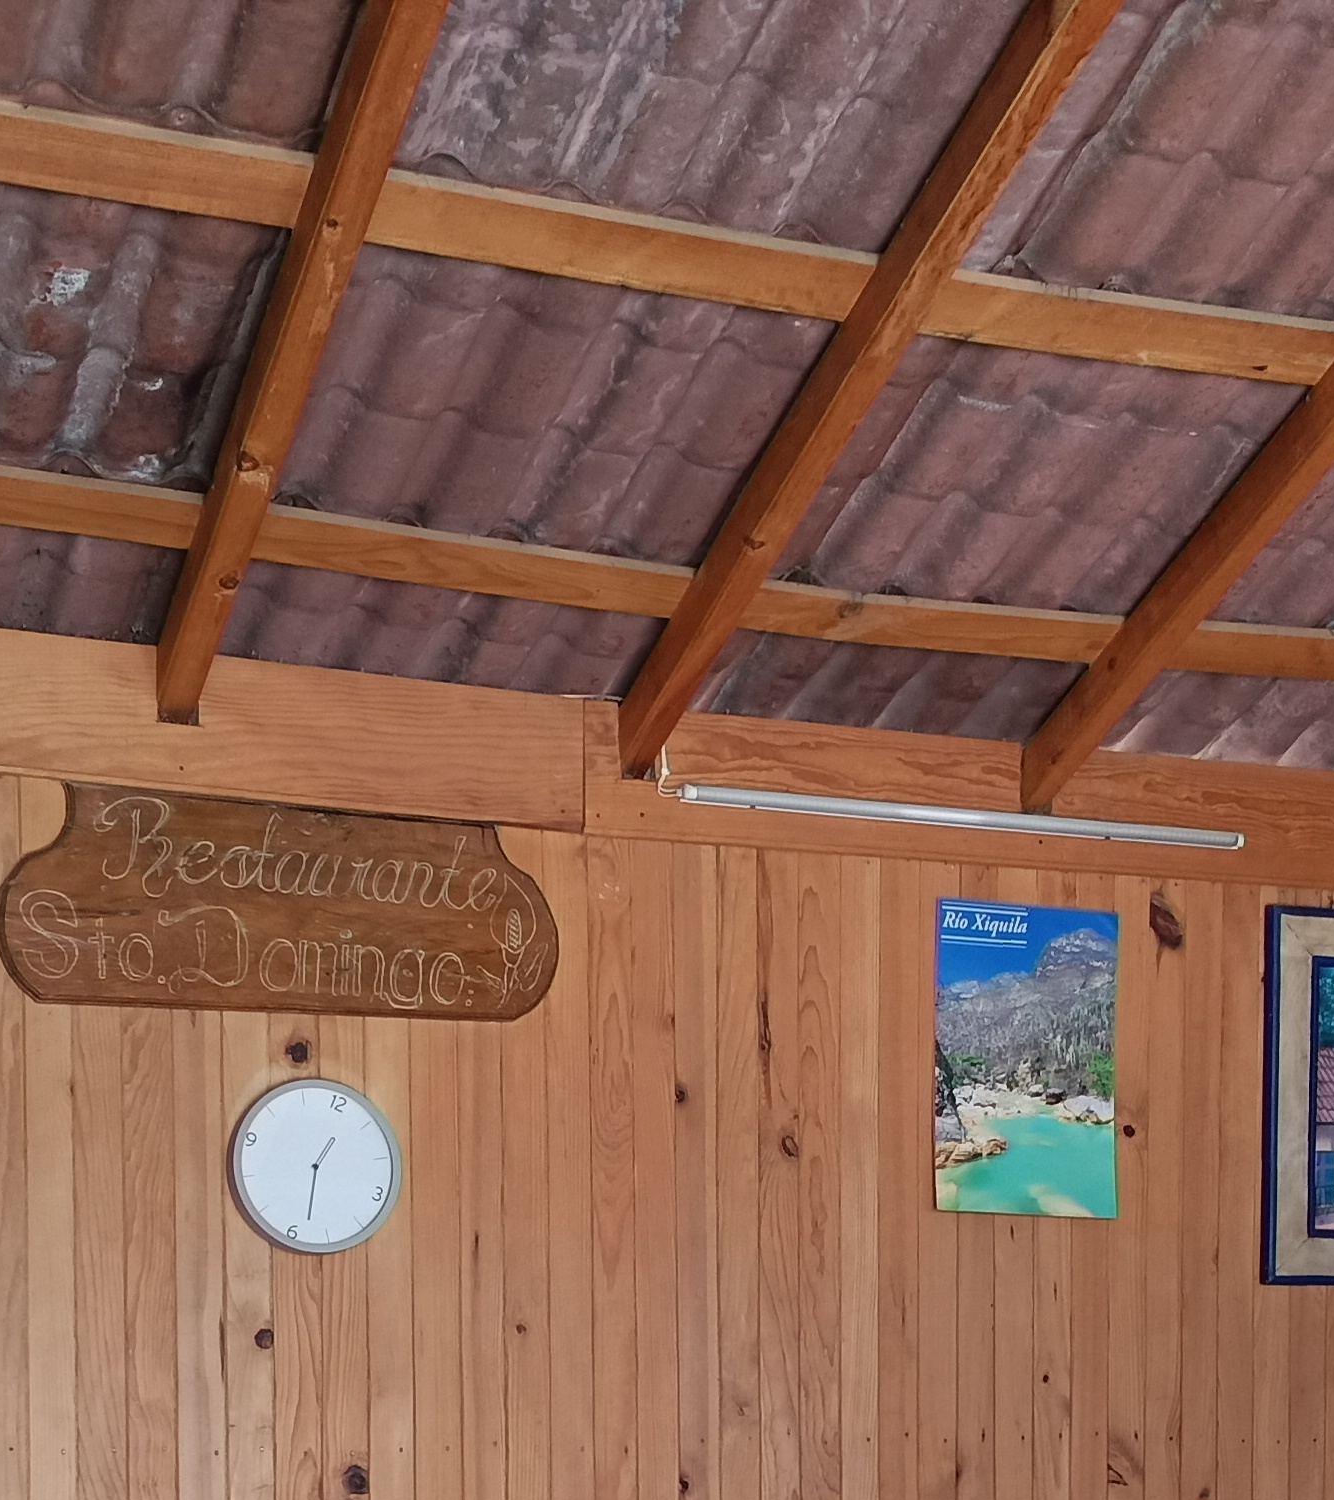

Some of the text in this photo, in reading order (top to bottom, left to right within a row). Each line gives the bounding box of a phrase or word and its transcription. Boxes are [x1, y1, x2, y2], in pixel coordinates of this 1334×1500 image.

[92, 796, 500, 912] Restaurante
[942, 911, 1028, 938] Río Xiquila
[330, 1095, 347, 1113] 12
[245, 1132, 257, 1147] 9
[372, 1186, 384, 1202] 3
[286, 1225, 298, 1240] 6
